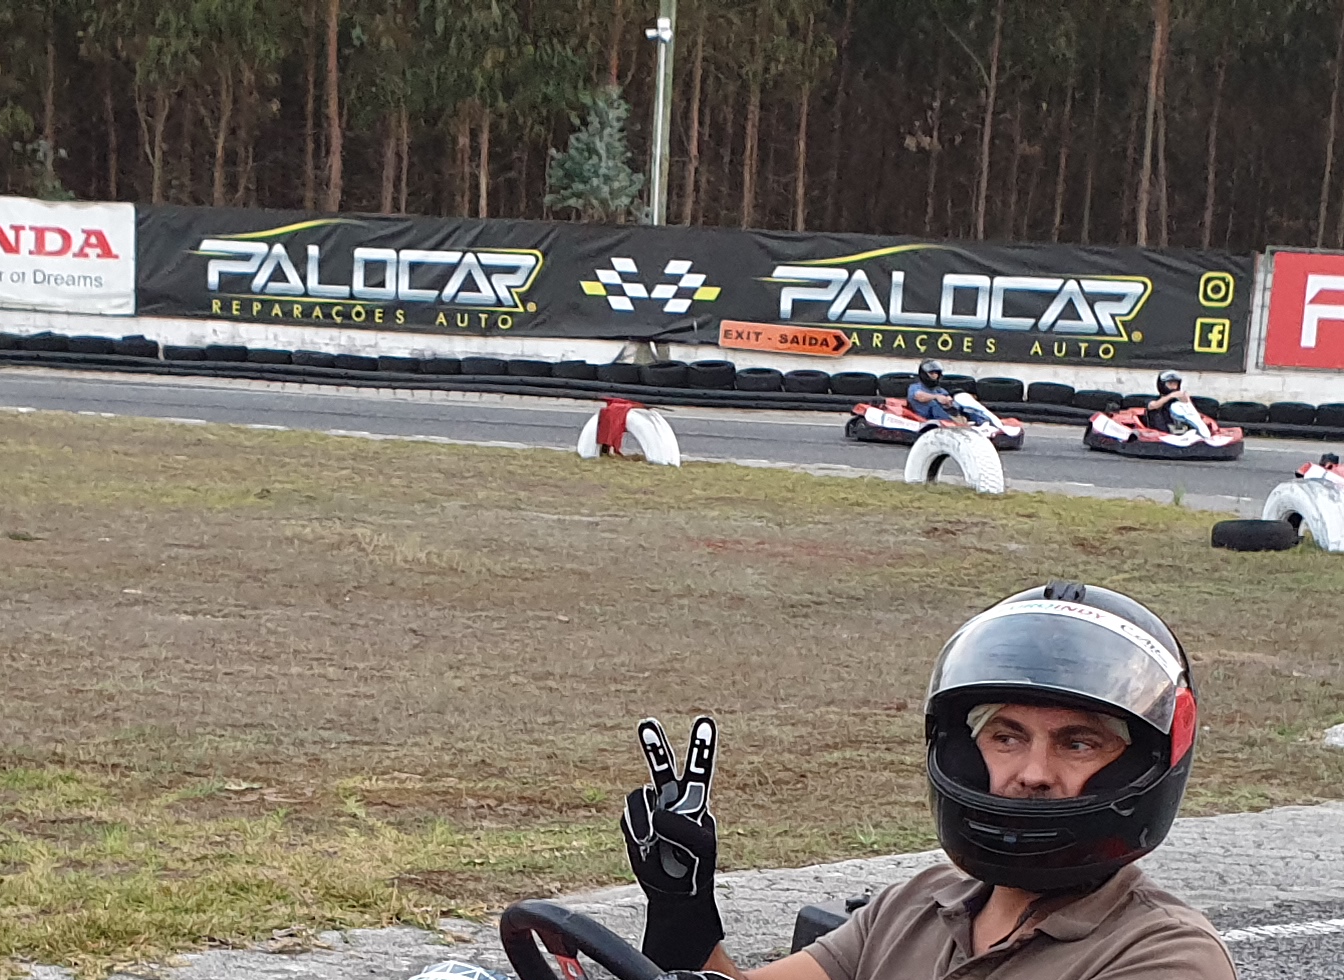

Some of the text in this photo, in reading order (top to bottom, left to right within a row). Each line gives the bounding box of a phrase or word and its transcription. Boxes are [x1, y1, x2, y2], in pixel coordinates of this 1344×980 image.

[10, 266, 27, 284] of
[33, 268, 104, 289] Dreams
[197, 238, 540, 309] PALOCAR
[211, 300, 514, 330] REPARAÇÕES AUTO
[771, 264, 1148, 337] PALOCAR
[723, 328, 763, 343] EXIT
[777, 331, 831, 349] SAÍDA
[849, 331, 1116, 360] ARAÇÕES AUTO
